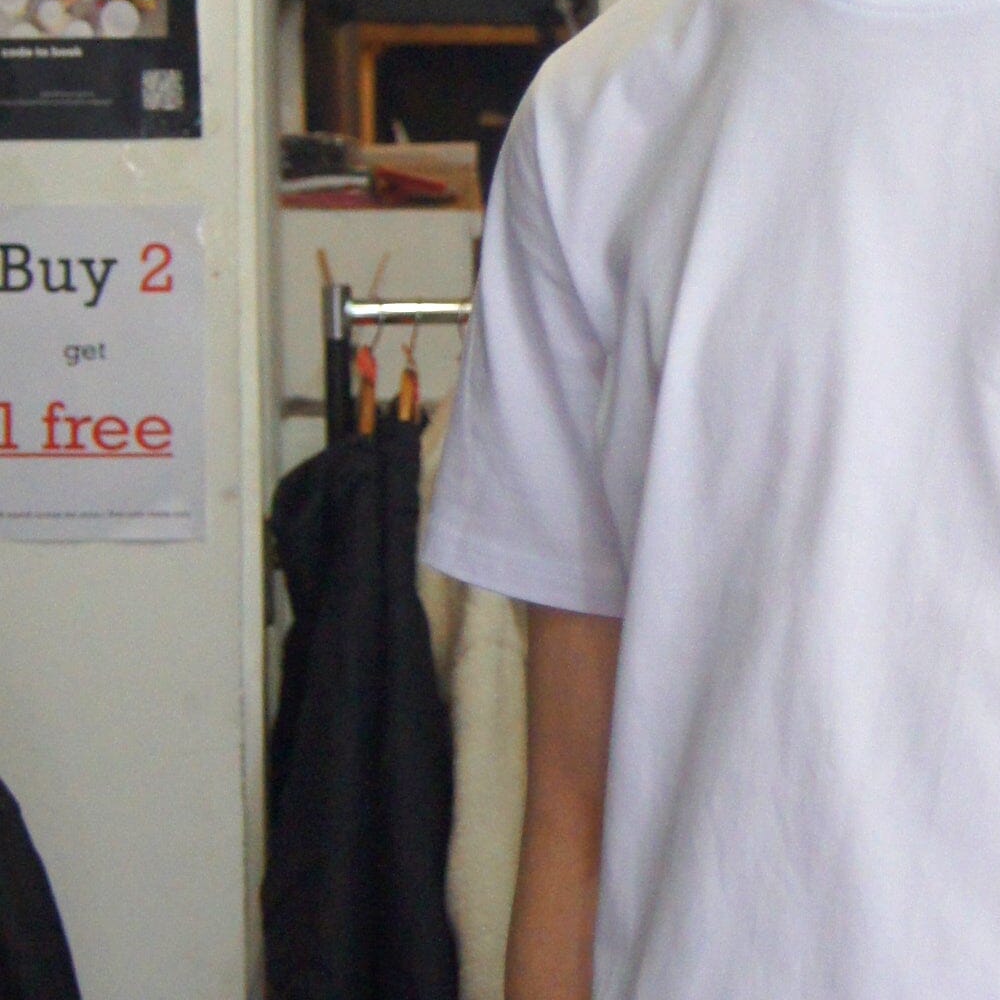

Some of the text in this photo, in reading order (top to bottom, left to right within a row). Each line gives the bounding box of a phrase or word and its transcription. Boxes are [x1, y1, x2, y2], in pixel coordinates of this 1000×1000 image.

[0, 241, 173, 307] Buy 2
[64, 343, 106, 367] get
[0, 400, 173, 451] 1 free
